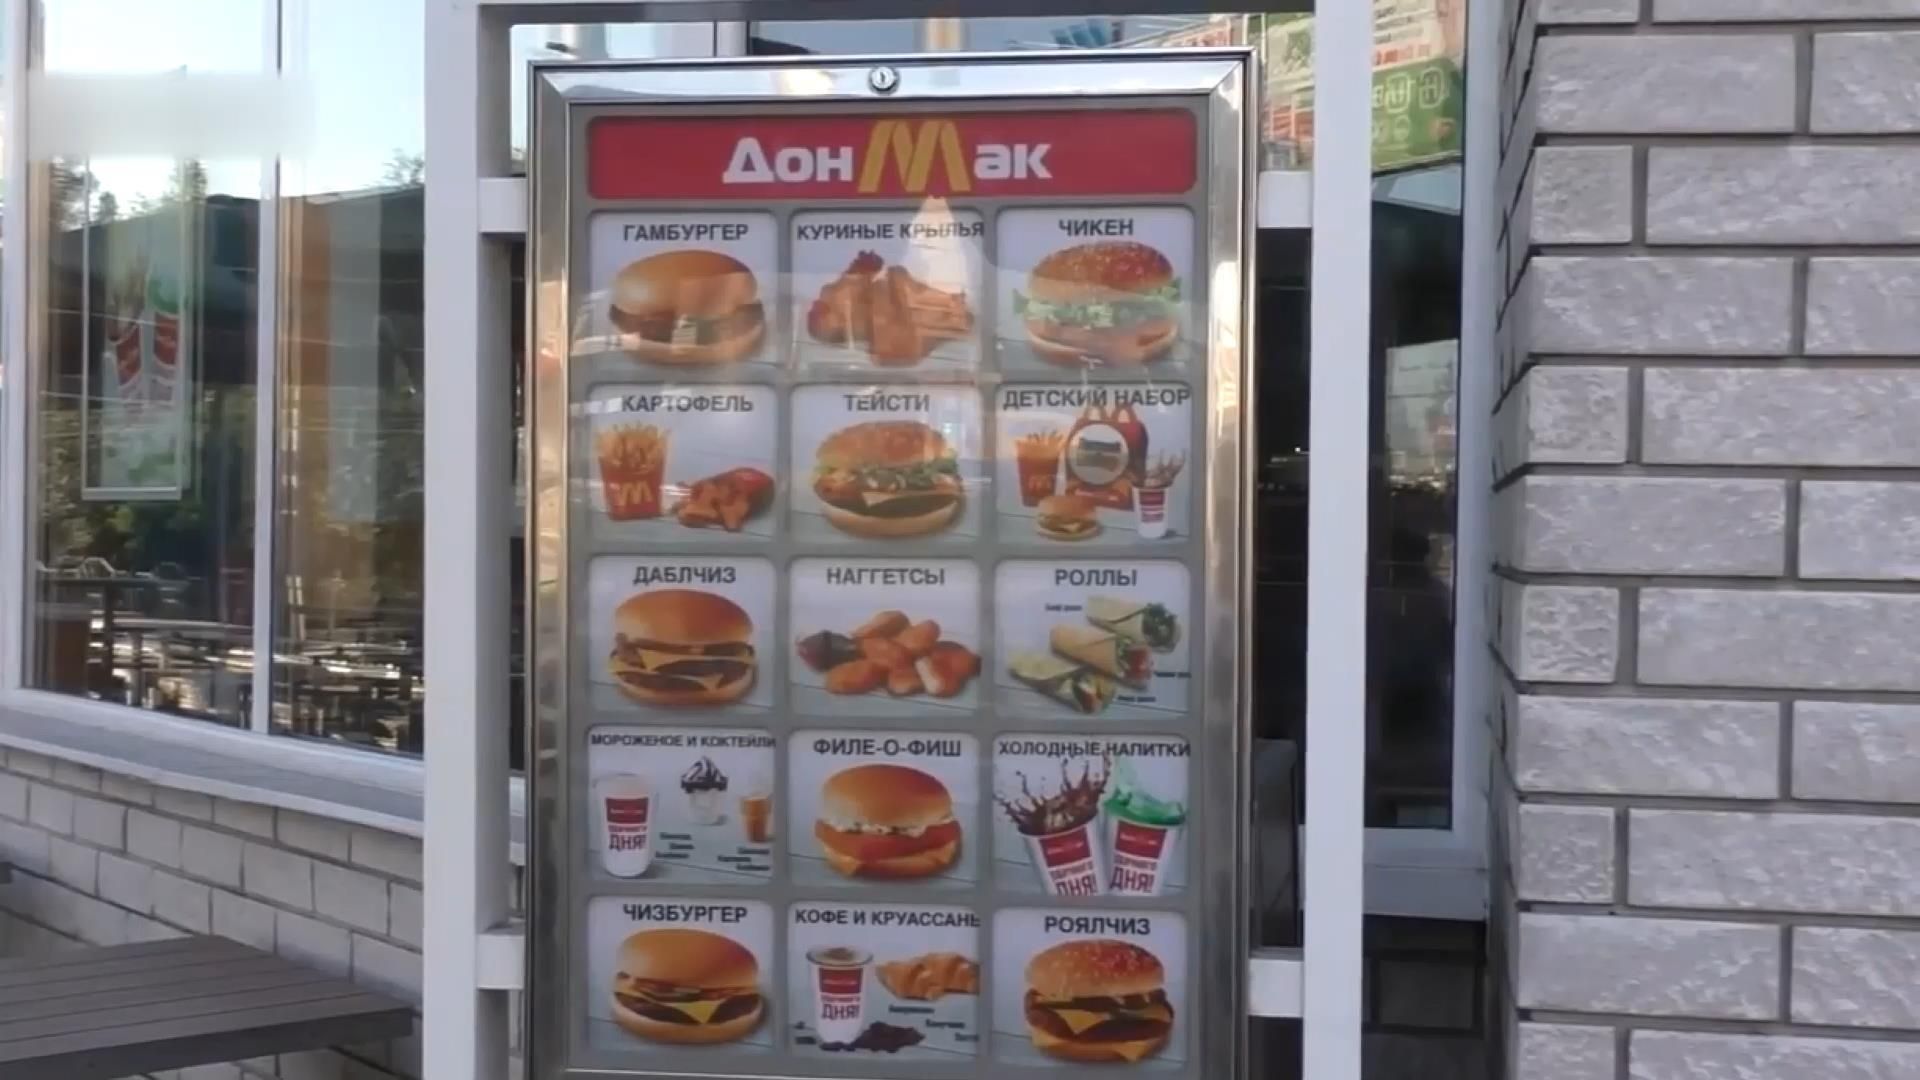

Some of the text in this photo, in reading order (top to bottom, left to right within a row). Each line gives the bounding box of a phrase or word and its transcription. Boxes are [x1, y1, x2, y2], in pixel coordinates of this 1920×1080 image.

[623, 223, 749, 242] ГАМБУРГЕР
[797, 222, 985, 241] КУРИНЫЕ КРЫЛЬЯ
[1058, 217, 1134, 237] ЧИКЕН
[621, 393, 754, 413] КАРТОФЕЛЬ
[843, 391, 930, 413] ТЕЙСТИ
[1003, 386, 1191, 411] ДЕТСКИЙ НАБОР
[632, 565, 737, 585] ДАБЛЧИЗ
[826, 567, 946, 585] НАГГЕТСЫ
[1054, 568, 1138, 587] РОЛЛЫ
[590, 733, 684, 748] МОРОЖЕНОЕ
[686, 735, 698, 748] И
[812, 737, 962, 758] ФИЛЕ-О-ФИШ
[999, 740, 1192, 759] ХОЛОДНЫЕ НАПИТКИ
[622, 903, 748, 923] ЧИЗБУРГЕР
[794, 908, 849, 925] КОФЕ
[853, 910, 867, 925] И
[1043, 915, 1151, 936] РОЯЛЧИЗ
